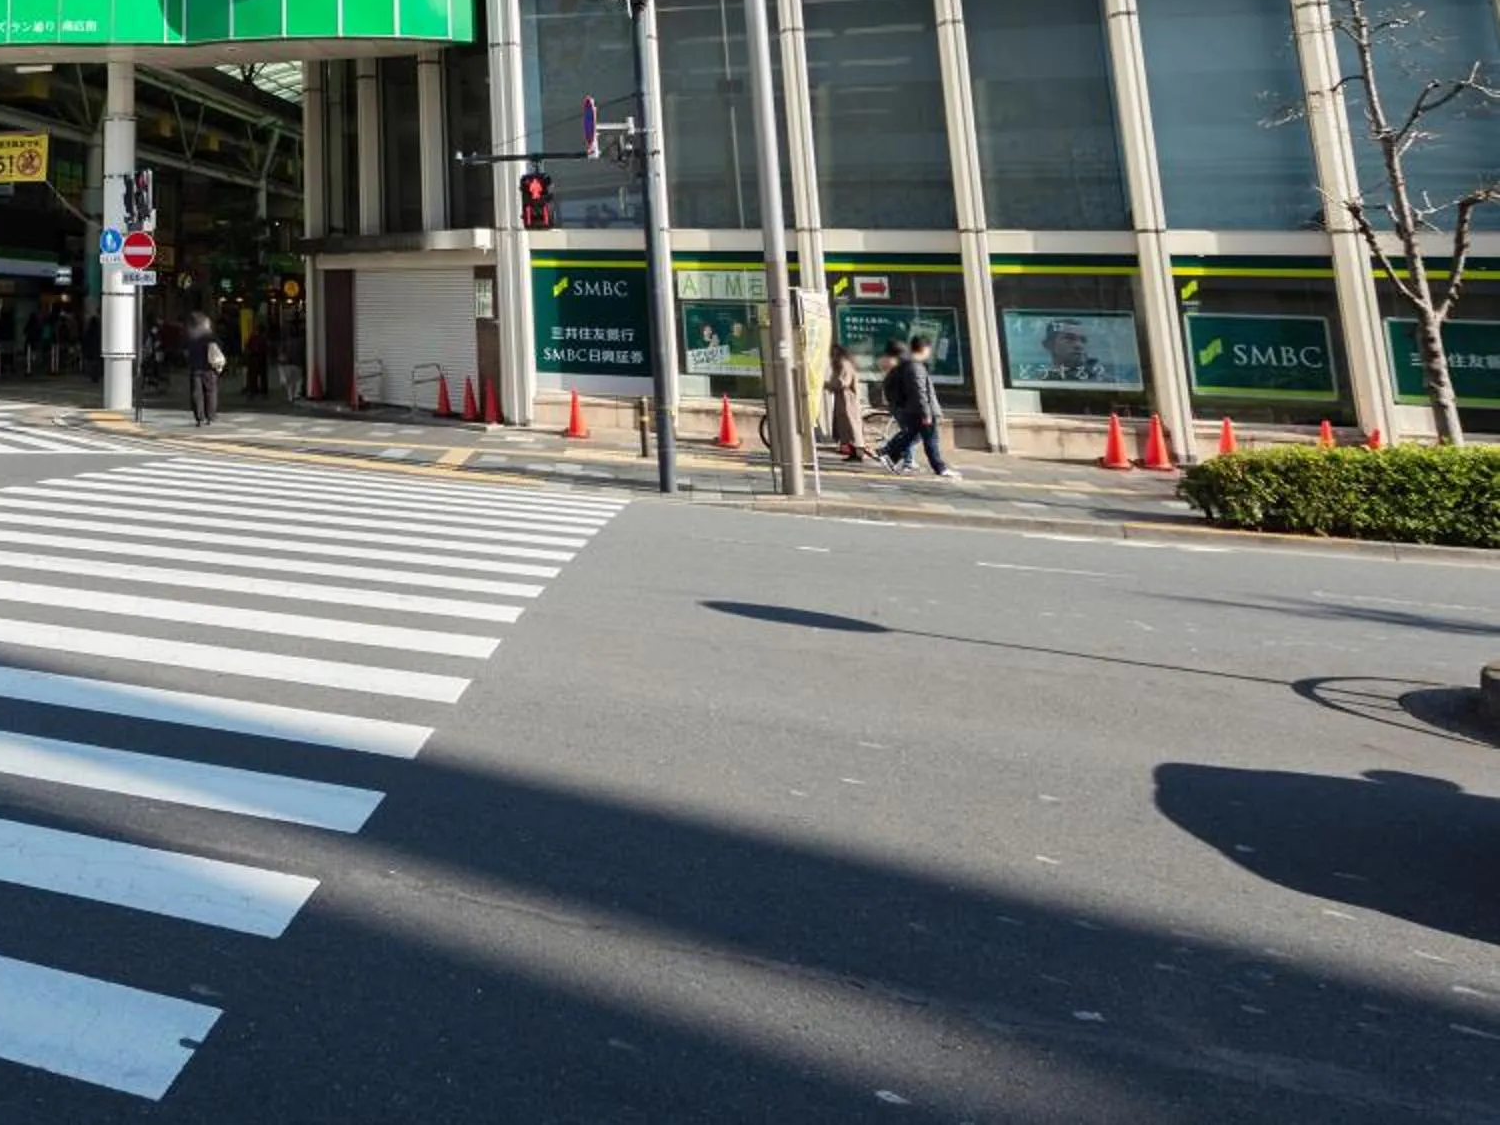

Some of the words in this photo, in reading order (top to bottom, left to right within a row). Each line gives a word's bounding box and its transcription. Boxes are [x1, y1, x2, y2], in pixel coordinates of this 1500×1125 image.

[573, 280, 629, 297] SMBC
[551, 327, 635, 342] 三井住友銀行
[543, 347, 645, 365] SMBC日興証券
[1233, 344, 1324, 369] SMBC
